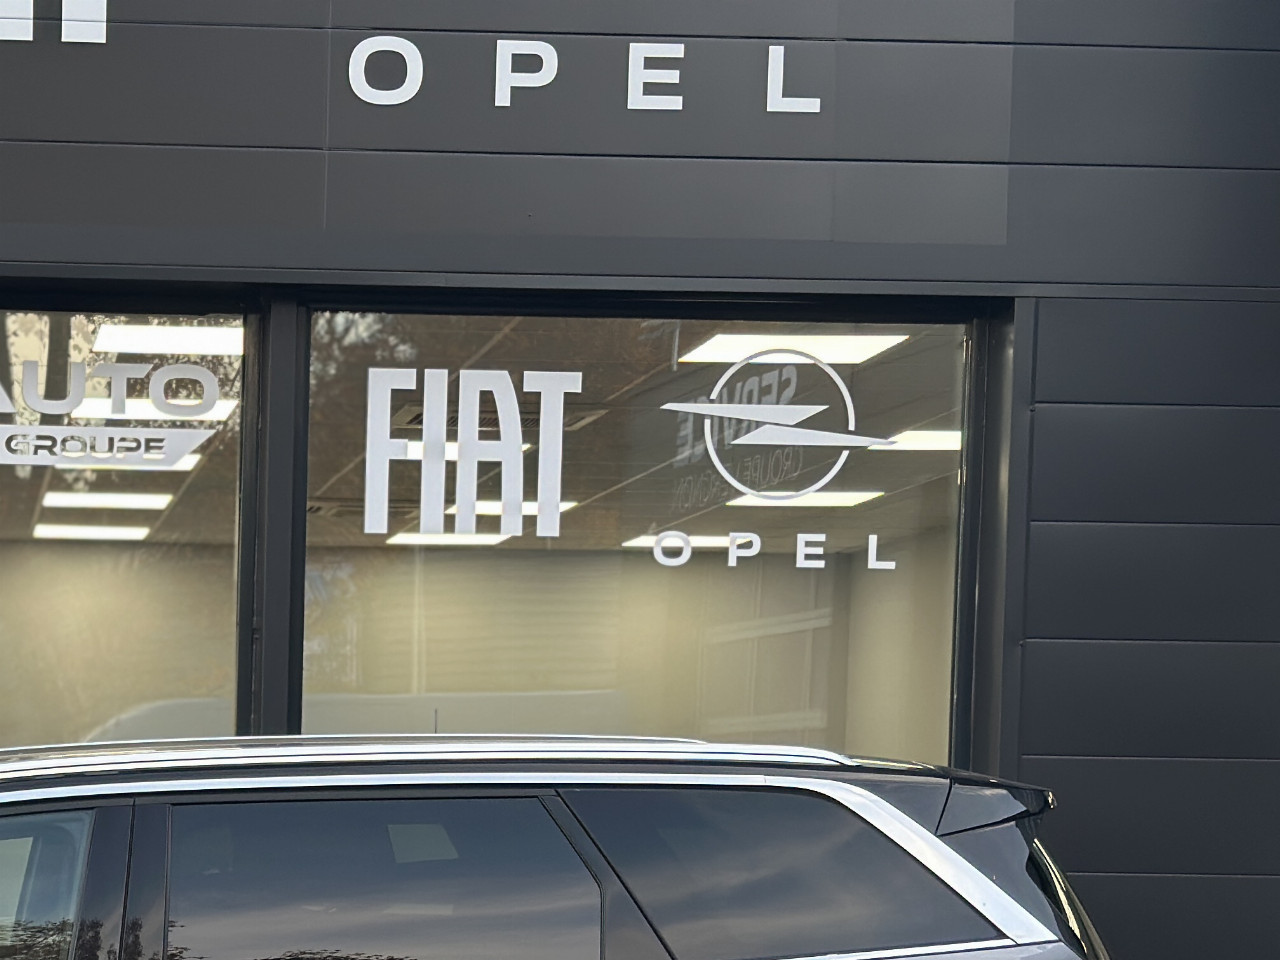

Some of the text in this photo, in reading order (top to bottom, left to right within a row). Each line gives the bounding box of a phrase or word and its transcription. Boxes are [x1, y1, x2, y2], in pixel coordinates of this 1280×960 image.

[348, 36, 821, 113] OPEL
[3, 434, 166, 460] GROUPE
[363, 367, 583, 538] FIAT
[652, 530, 897, 570] OPEL
